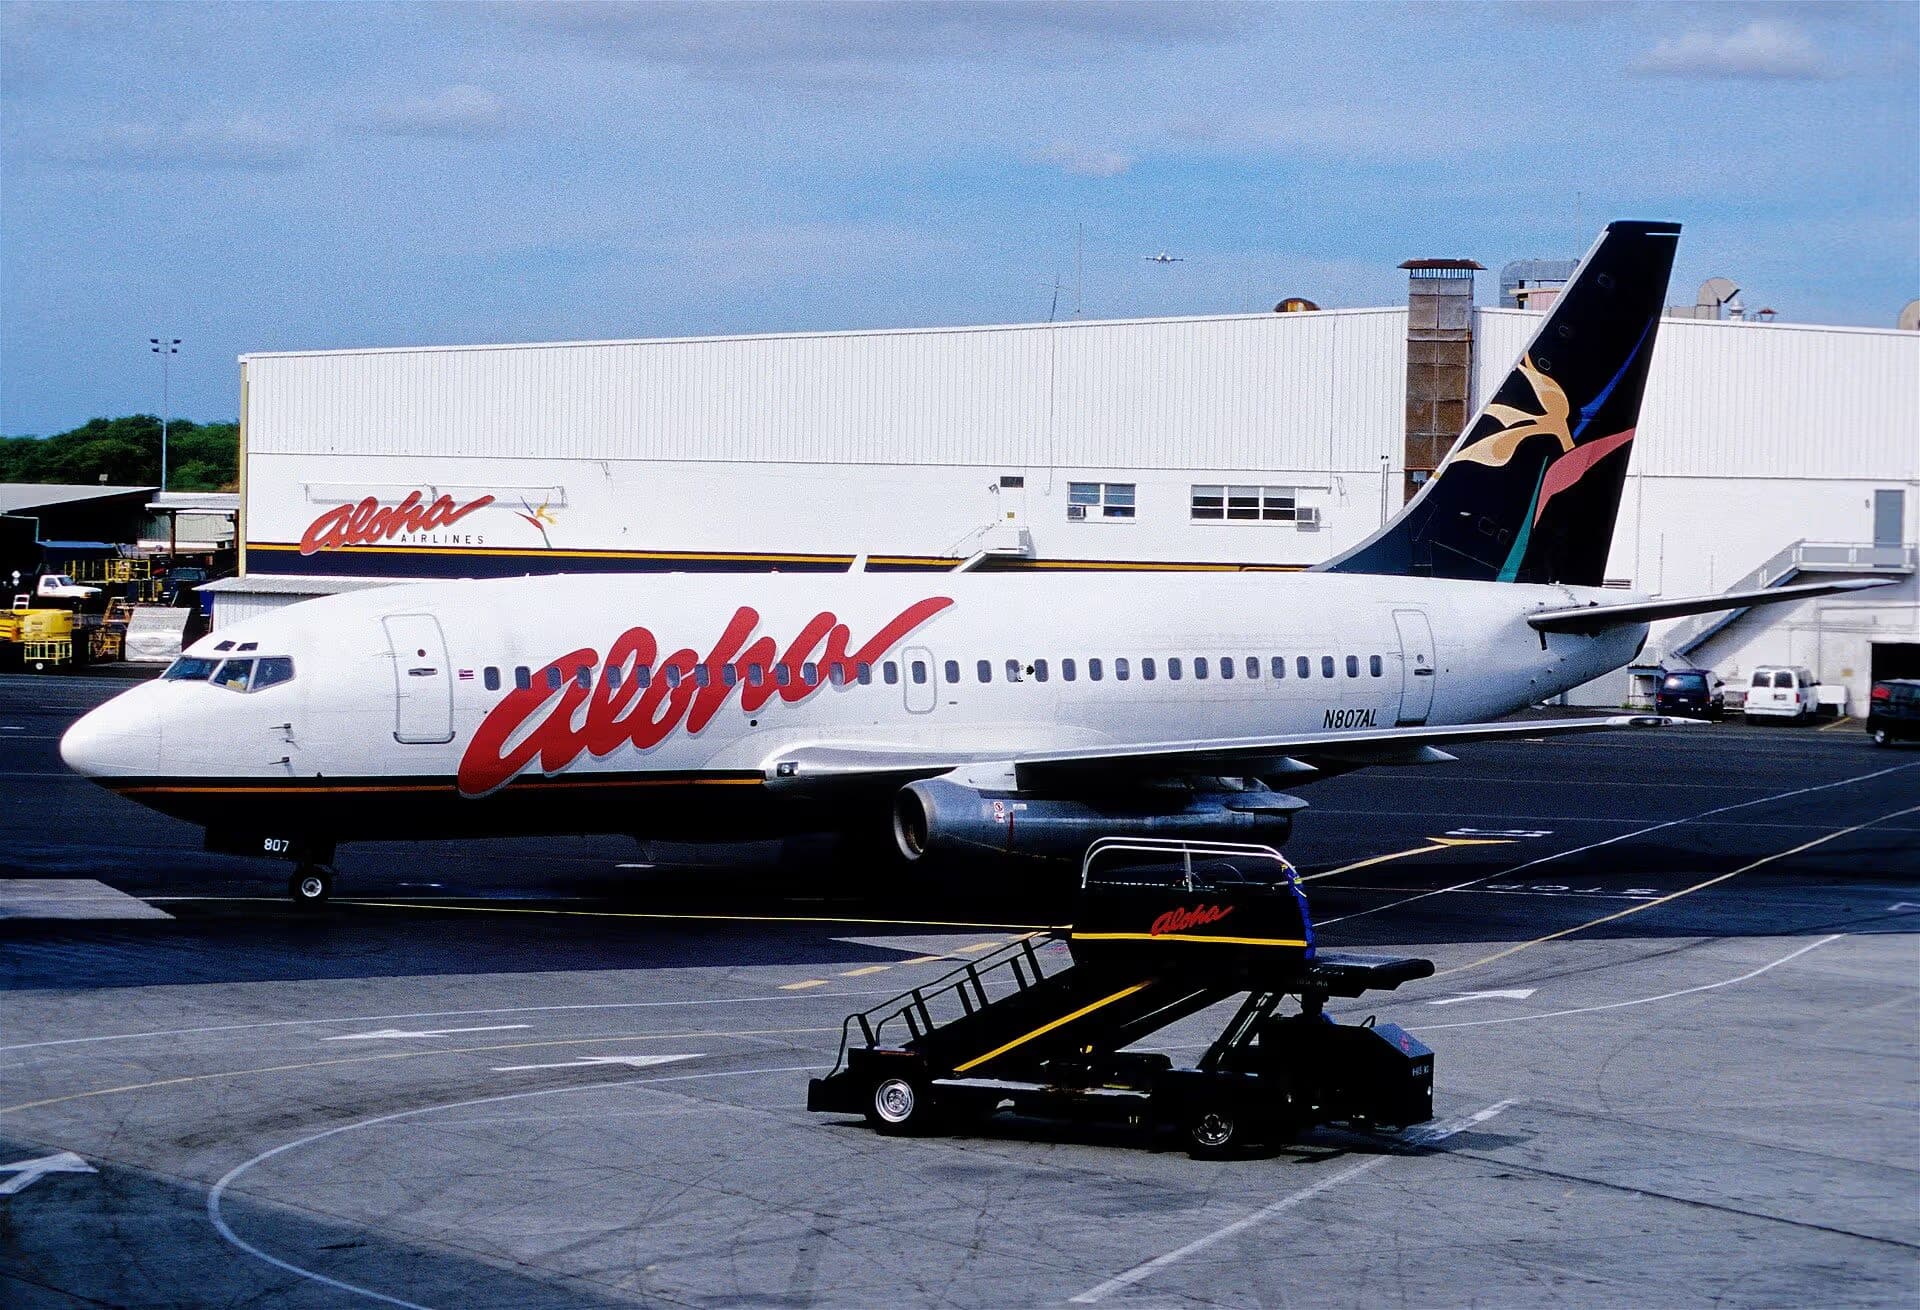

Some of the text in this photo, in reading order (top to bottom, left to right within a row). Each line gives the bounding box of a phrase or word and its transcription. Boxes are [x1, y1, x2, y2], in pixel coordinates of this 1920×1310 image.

[401, 534, 485, 545] AIRLINES
[1323, 708, 1377, 729] N807AL
[264, 838, 290, 853] 807
